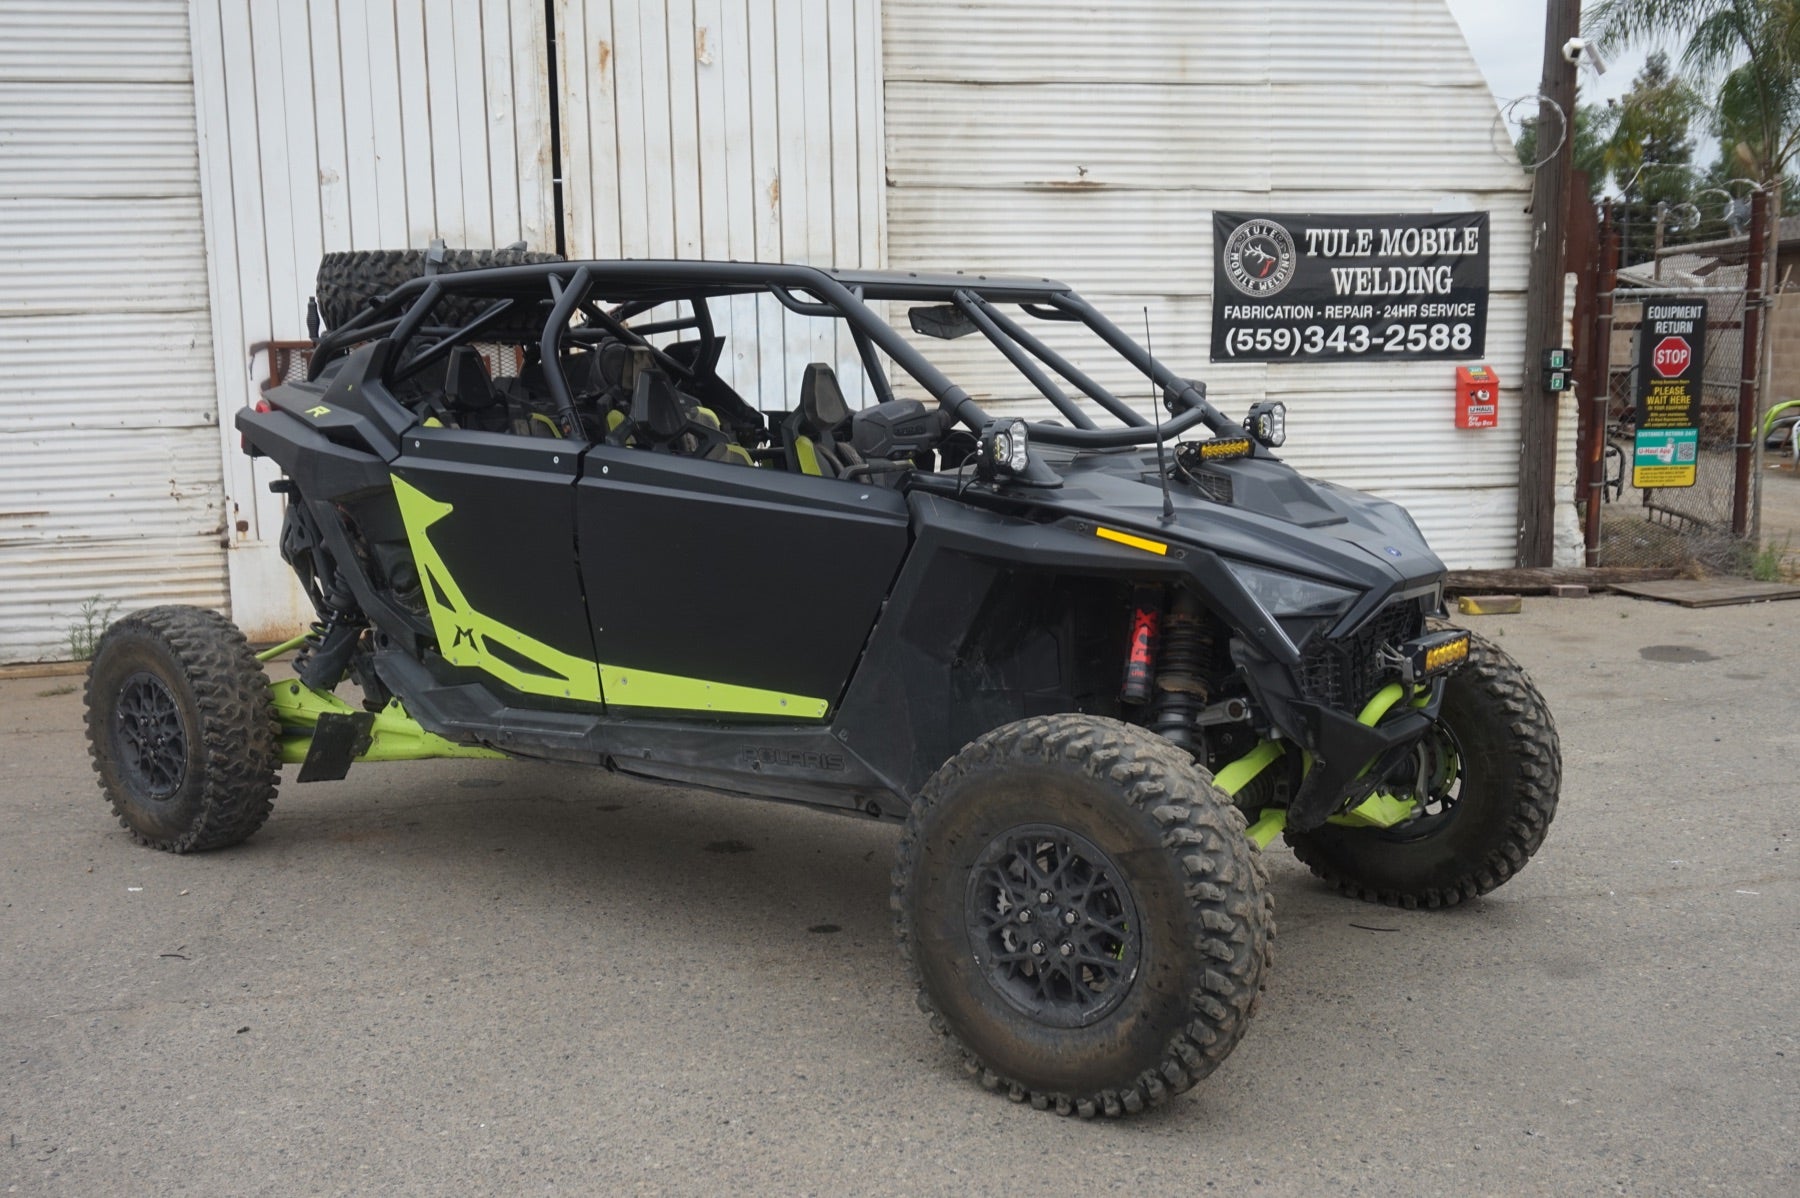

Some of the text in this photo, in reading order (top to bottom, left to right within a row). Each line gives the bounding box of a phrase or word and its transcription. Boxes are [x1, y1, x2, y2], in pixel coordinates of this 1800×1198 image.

[1244, 226, 1277, 237] TULE
[1305, 227, 1479, 257] TULE MOBILE
[1230, 252, 1290, 290] MOBILE WELDING
[1331, 266, 1453, 295] WELDING
[1224, 305, 1315, 319] FABRICATION
[1325, 305, 1373, 319] REPAIR
[1384, 304, 1417, 317] 24HR
[1420, 303, 1476, 317] SERVICE
[1648, 305, 1703, 319] EQUIPMENT
[1655, 321, 1693, 334] RETURN
[1225, 323, 1473, 356] (559)343-2588
[1657, 349, 1688, 364] STOP
[1654, 386, 1685, 396] PLEASE
[1647, 395, 1691, 405] WAIT HERE
[742, 745, 846, 772] POLARIS
